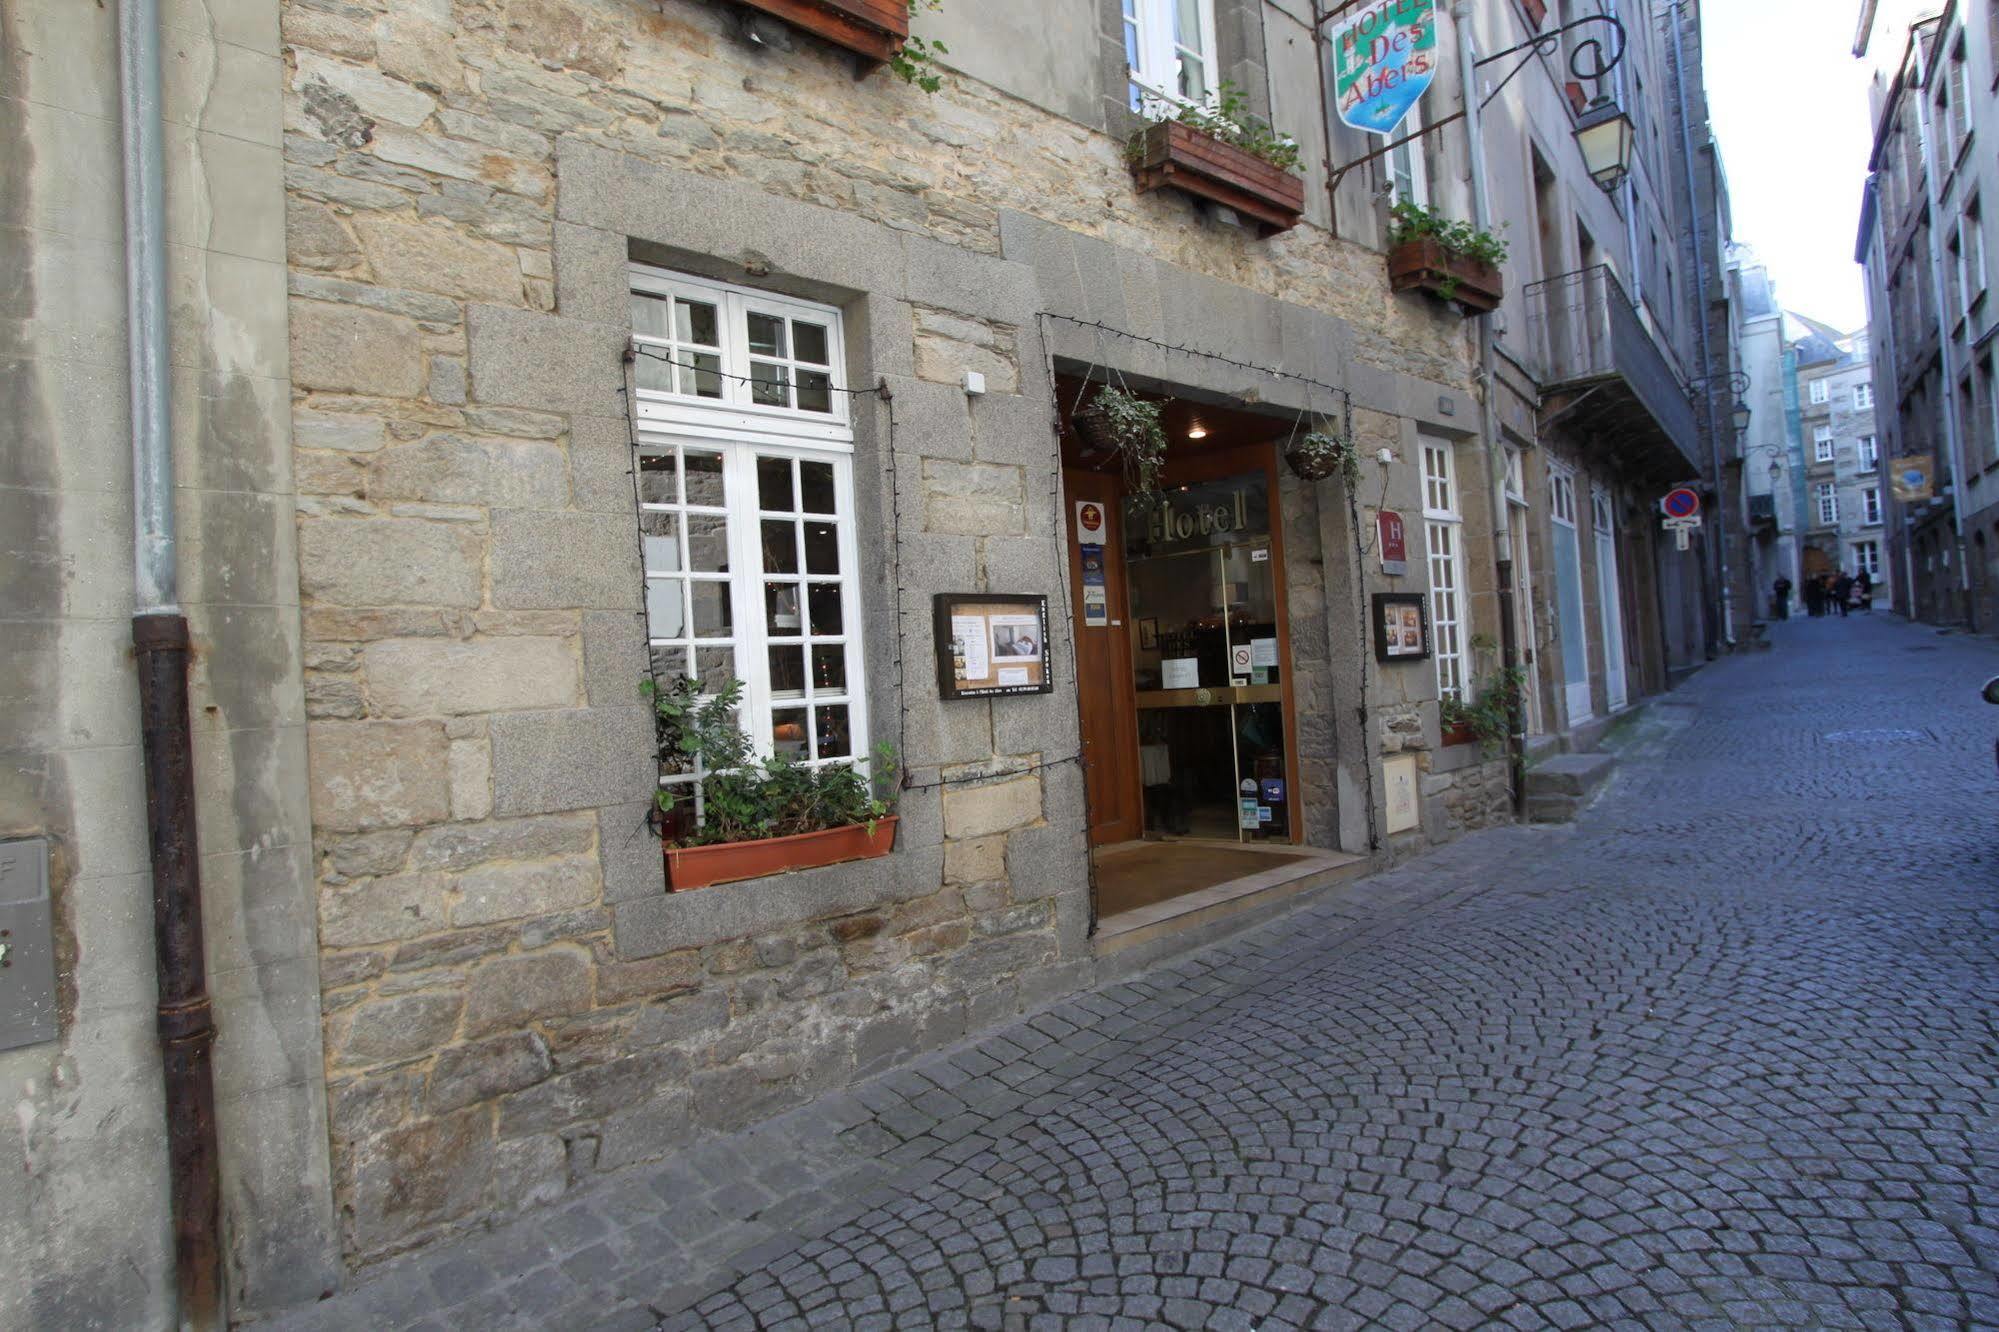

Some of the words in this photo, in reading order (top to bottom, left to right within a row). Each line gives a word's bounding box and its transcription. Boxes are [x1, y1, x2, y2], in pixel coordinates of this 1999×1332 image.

[1369, 23, 1425, 67] Des
[1343, 55, 1430, 111] Abers
[1146, 488, 1247, 544] Hotel
